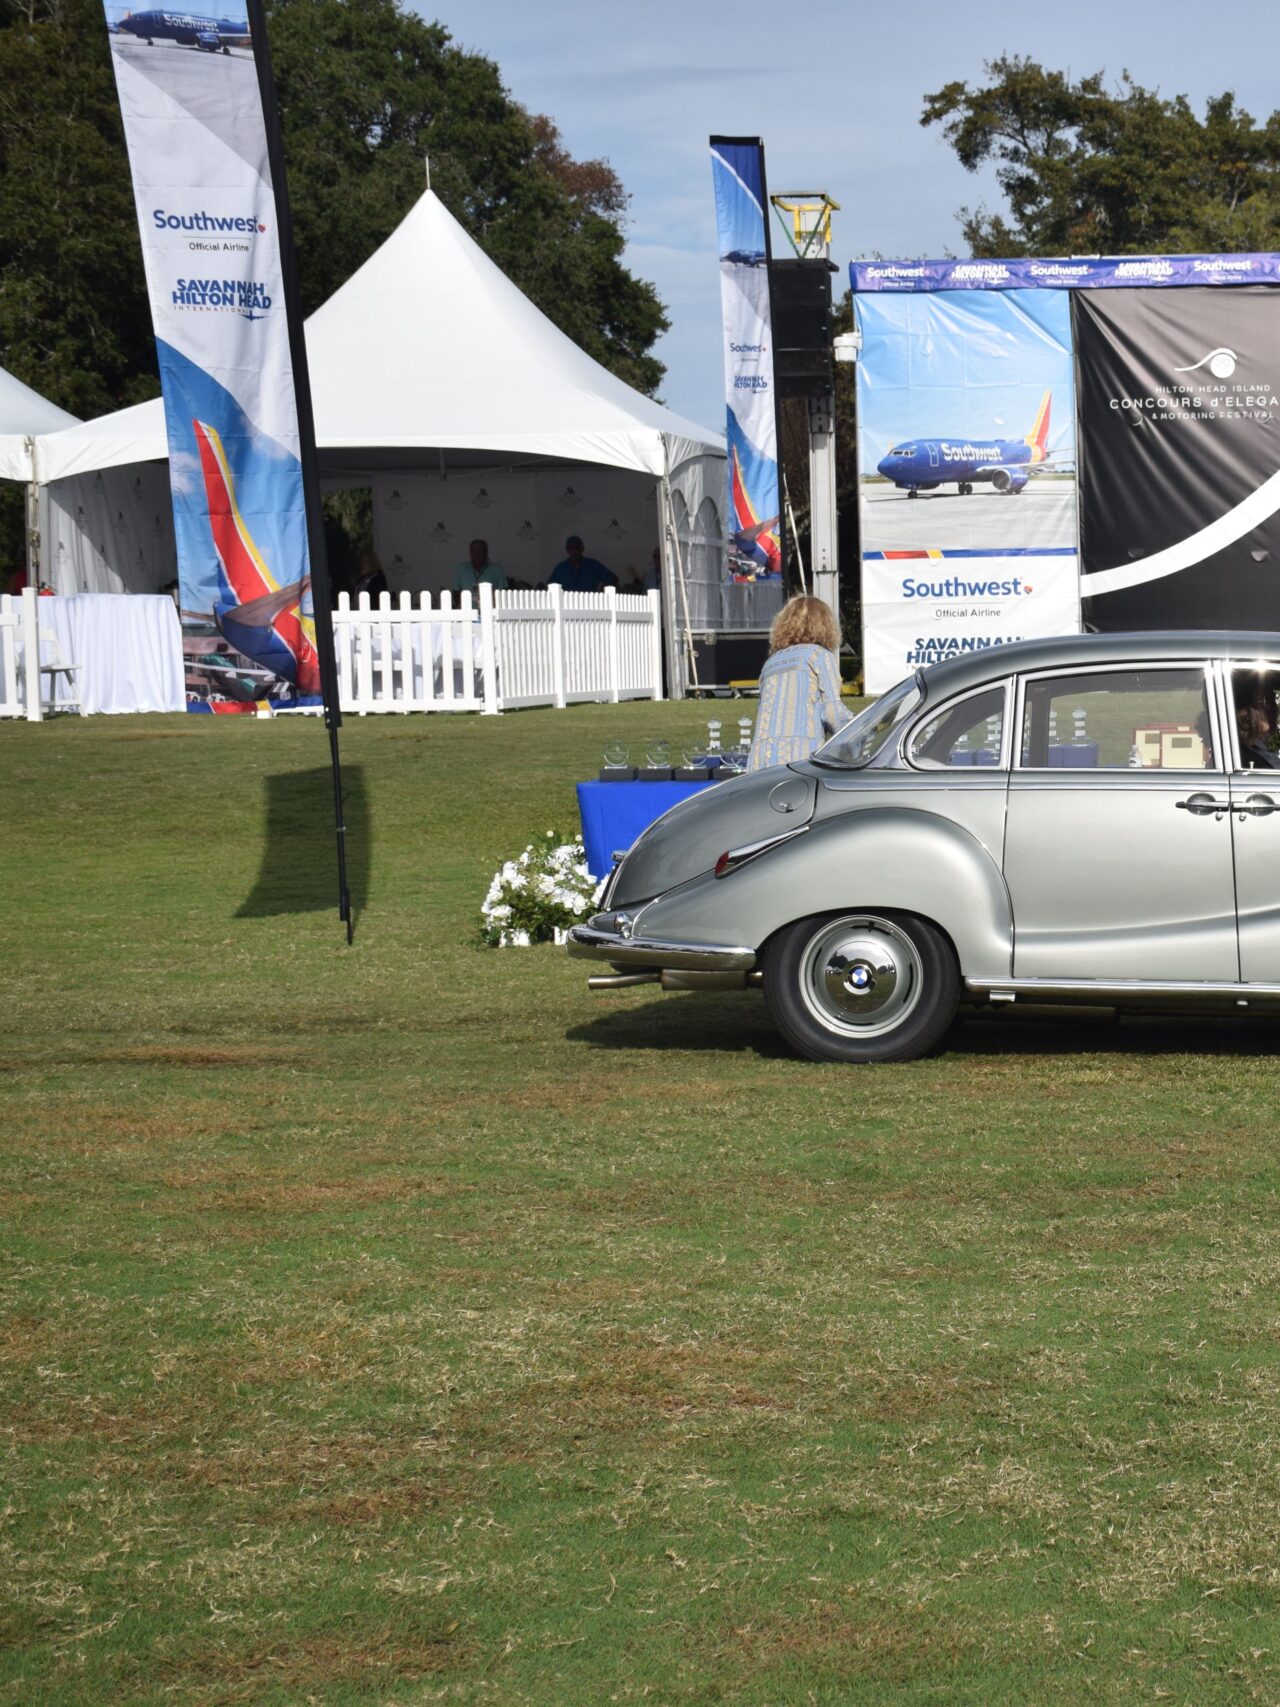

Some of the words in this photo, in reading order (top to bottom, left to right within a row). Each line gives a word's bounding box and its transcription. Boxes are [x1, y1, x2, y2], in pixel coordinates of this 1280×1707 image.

[152, 209, 259, 233] Southwest
[188, 242, 220, 251] Official
[222, 243, 250, 252] Airline
[867, 266, 924, 278] Southwest
[1030, 263, 1089, 276] Southwest
[1194, 260, 1252, 272] Southwest
[176, 278, 265, 296] SAVANNAH
[172, 291, 235, 306] HILTON
[238, 294, 272, 309] HEAD
[1155, 385, 1194, 394] HILTON
[1199, 385, 1228, 393] HEAD
[1232, 384, 1271, 393] ISLAND
[1109, 397, 1202, 410] CONCOURS
[1160, 412, 1216, 420] MOTORING
[1219, 411, 1275, 419] FESTIVAL
[942, 443, 1004, 462] Southwest
[902, 576, 1023, 599] Southwest
[935, 608, 968, 618] Official
[970, 608, 1002, 617] Airline
[914, 636, 1022, 651] SAVANNA
[906, 650, 966, 665] HILTO
